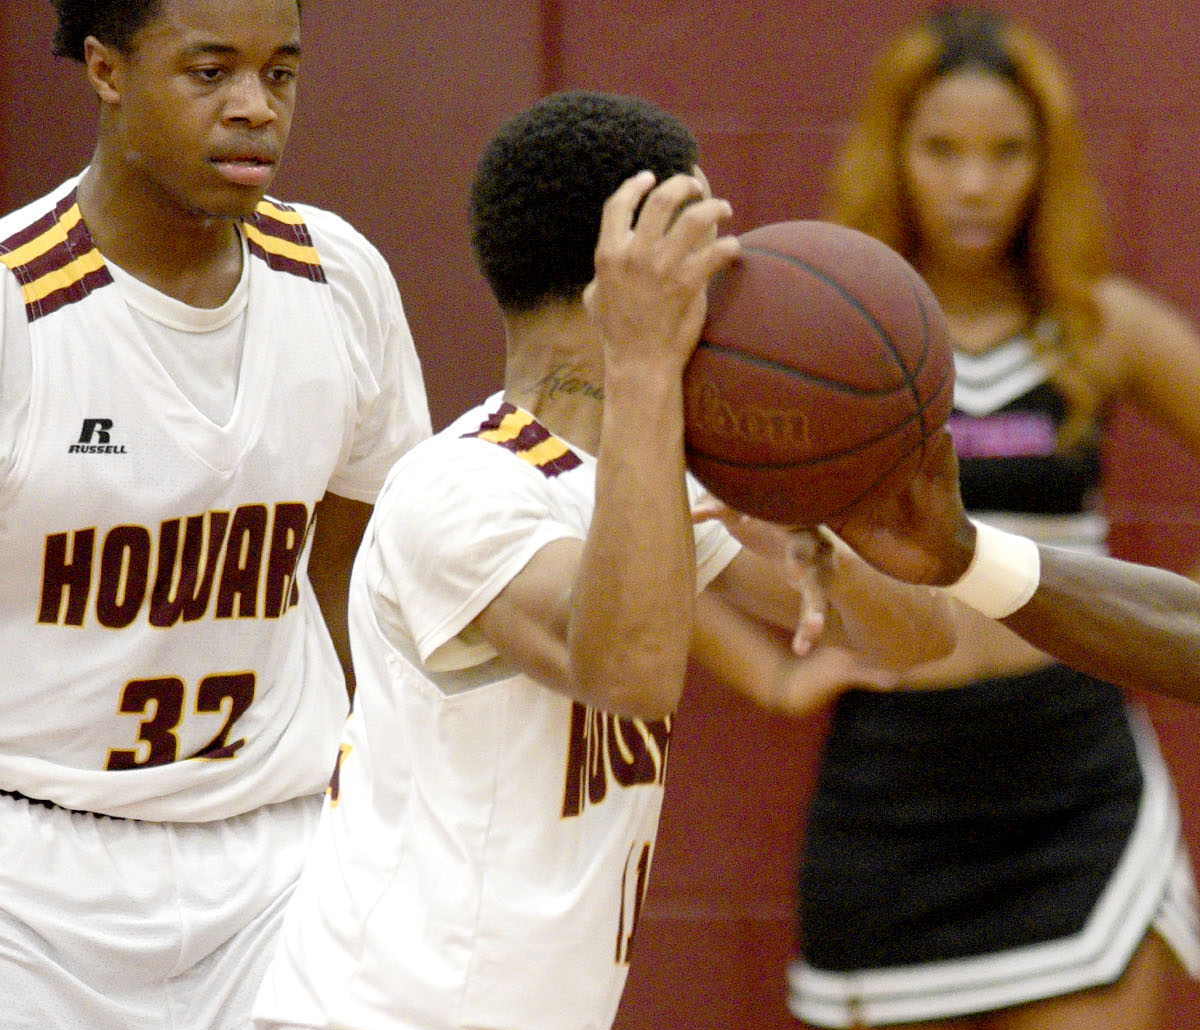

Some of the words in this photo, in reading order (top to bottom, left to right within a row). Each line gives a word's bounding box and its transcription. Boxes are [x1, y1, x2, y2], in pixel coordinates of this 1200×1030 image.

[68, 444, 127, 454] RUSSELL
[36, 500, 320, 631] HOWAR
[104, 669, 258, 771] 32
